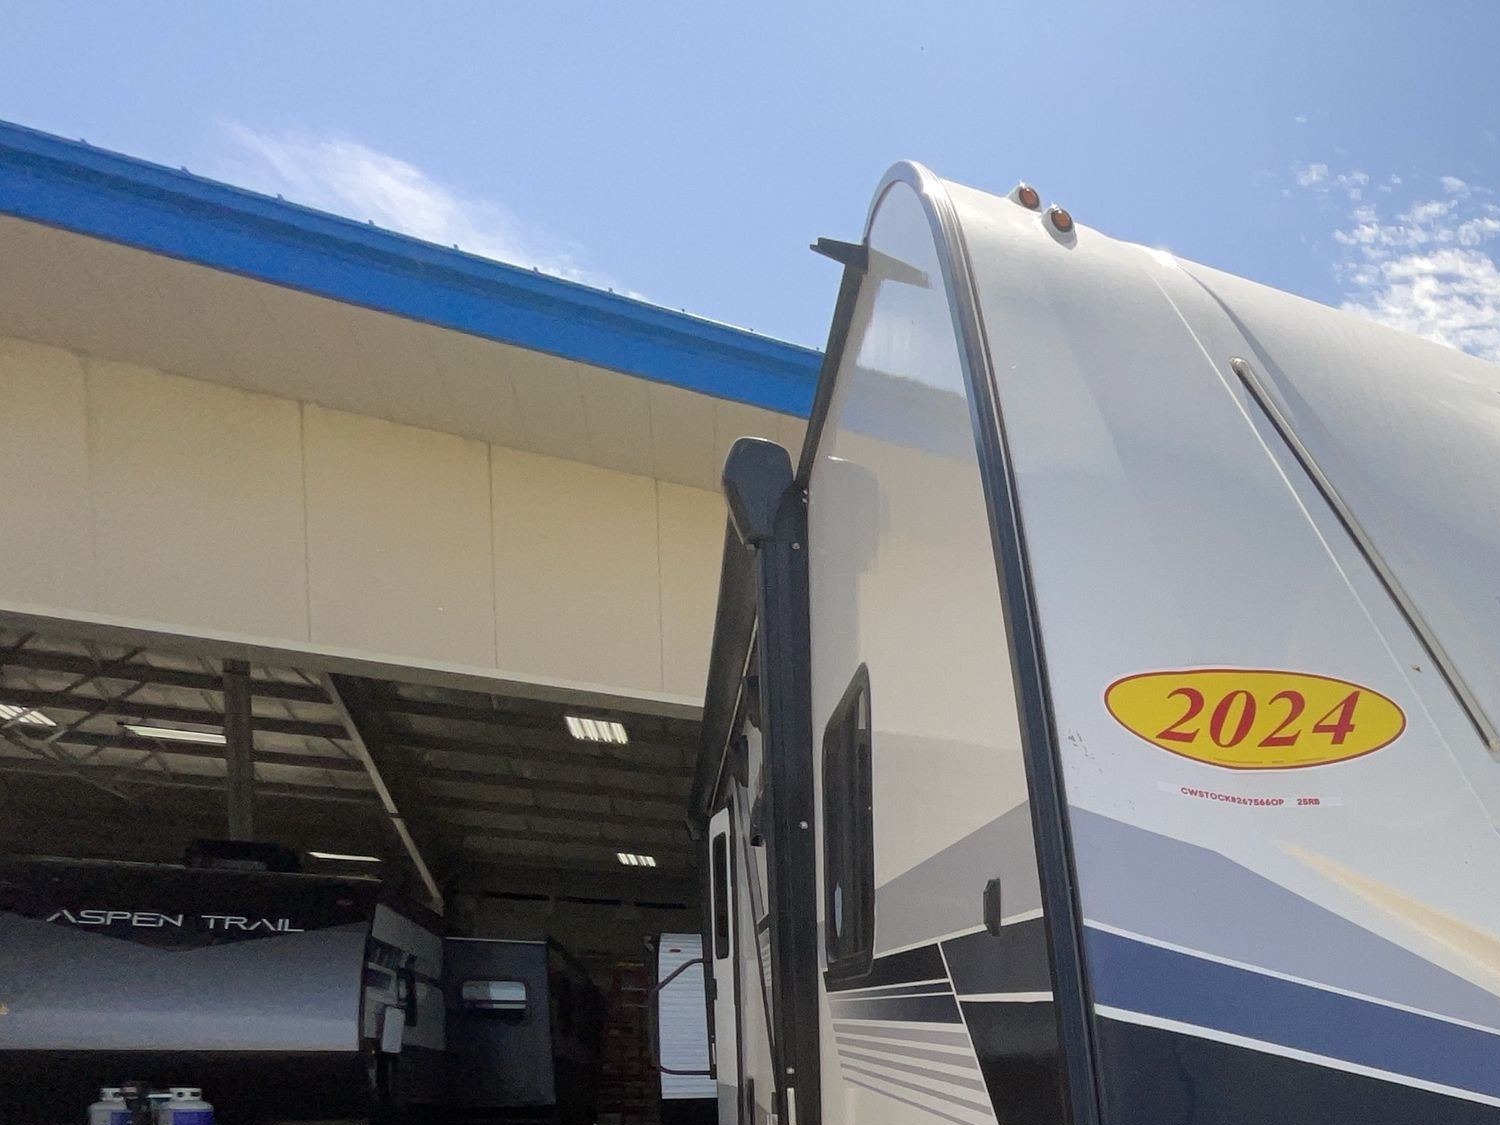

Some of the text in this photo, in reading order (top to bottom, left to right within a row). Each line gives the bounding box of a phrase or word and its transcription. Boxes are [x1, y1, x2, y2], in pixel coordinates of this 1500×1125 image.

[1156, 687, 1361, 748] 2024
[46, 909, 305, 932] ASPEN TRAIL
